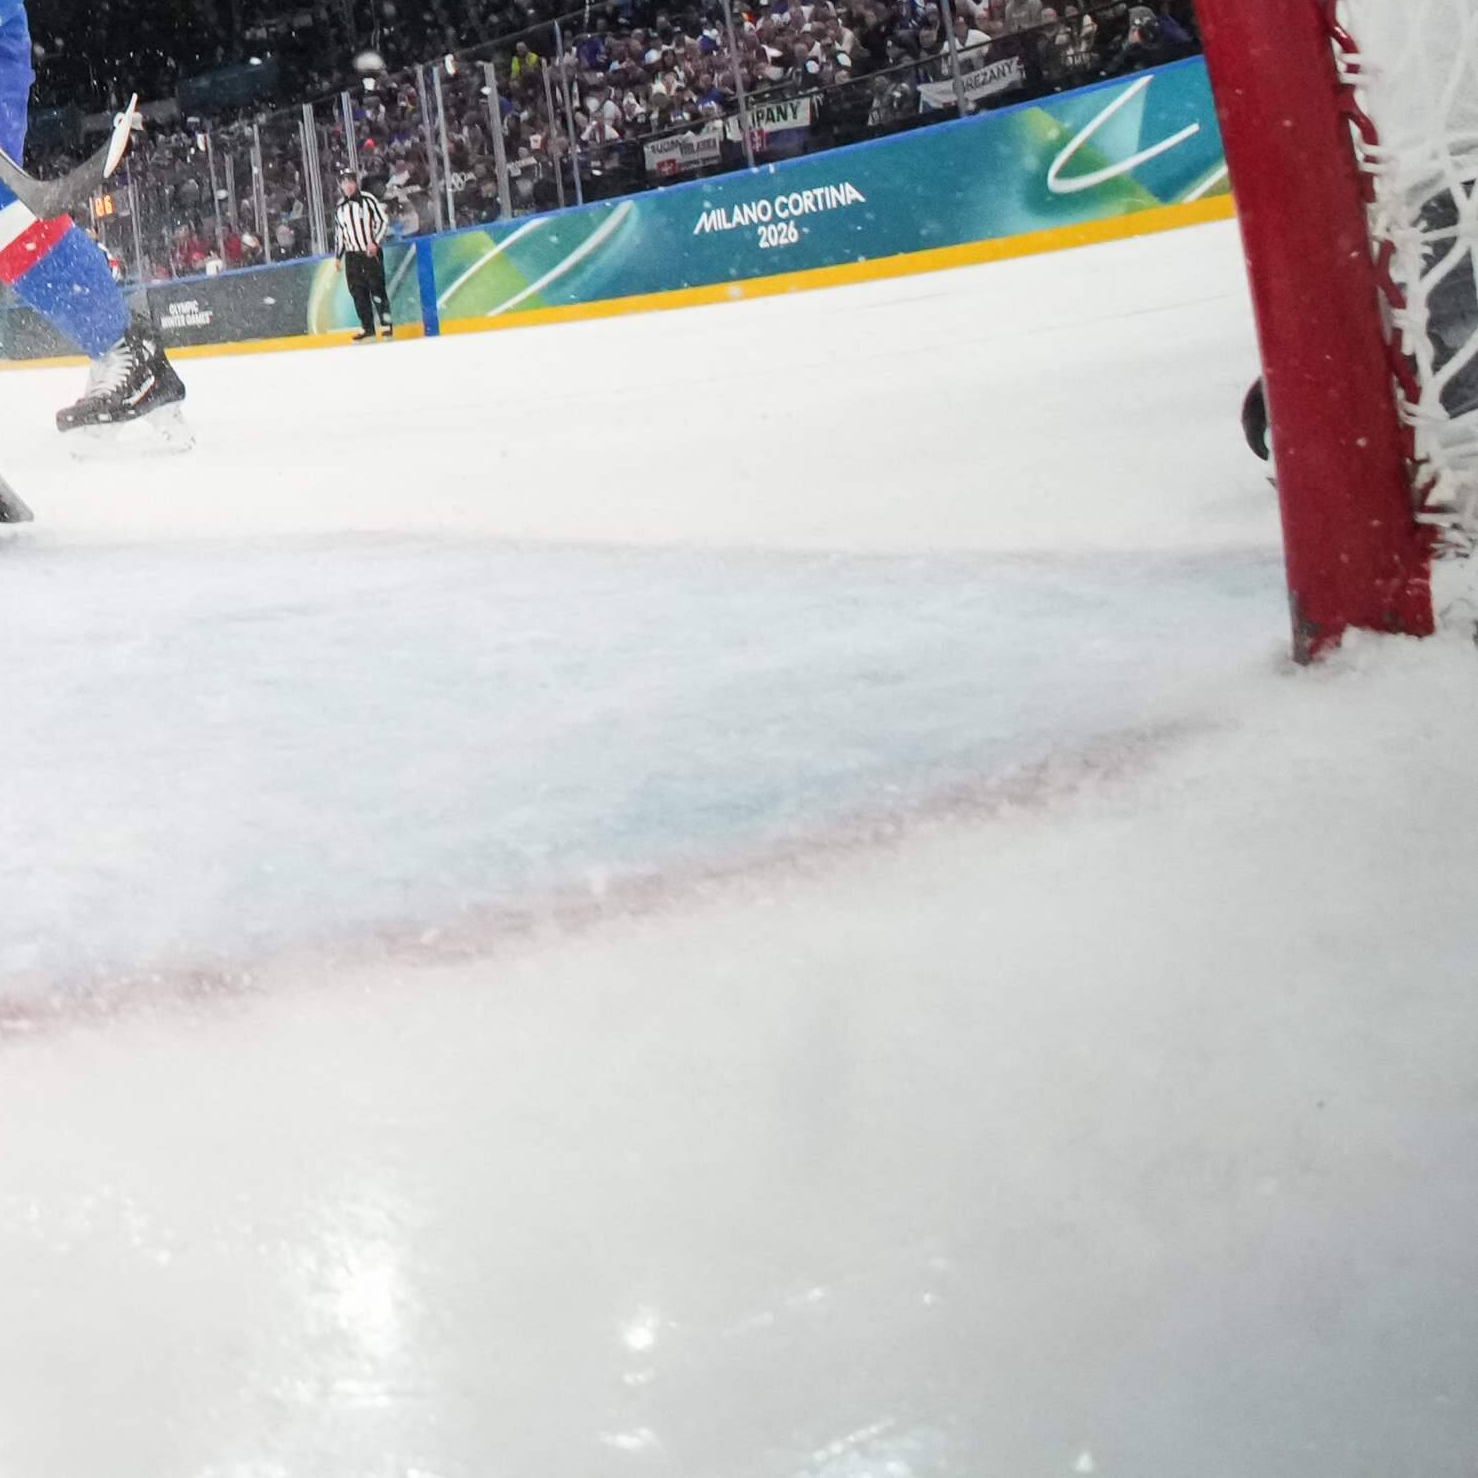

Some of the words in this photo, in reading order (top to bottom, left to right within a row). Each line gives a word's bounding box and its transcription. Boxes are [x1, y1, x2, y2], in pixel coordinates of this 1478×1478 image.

[693, 199, 772, 235] MILANO
[774, 182, 866, 219] CORTINA
[757, 219, 799, 249] 2026
